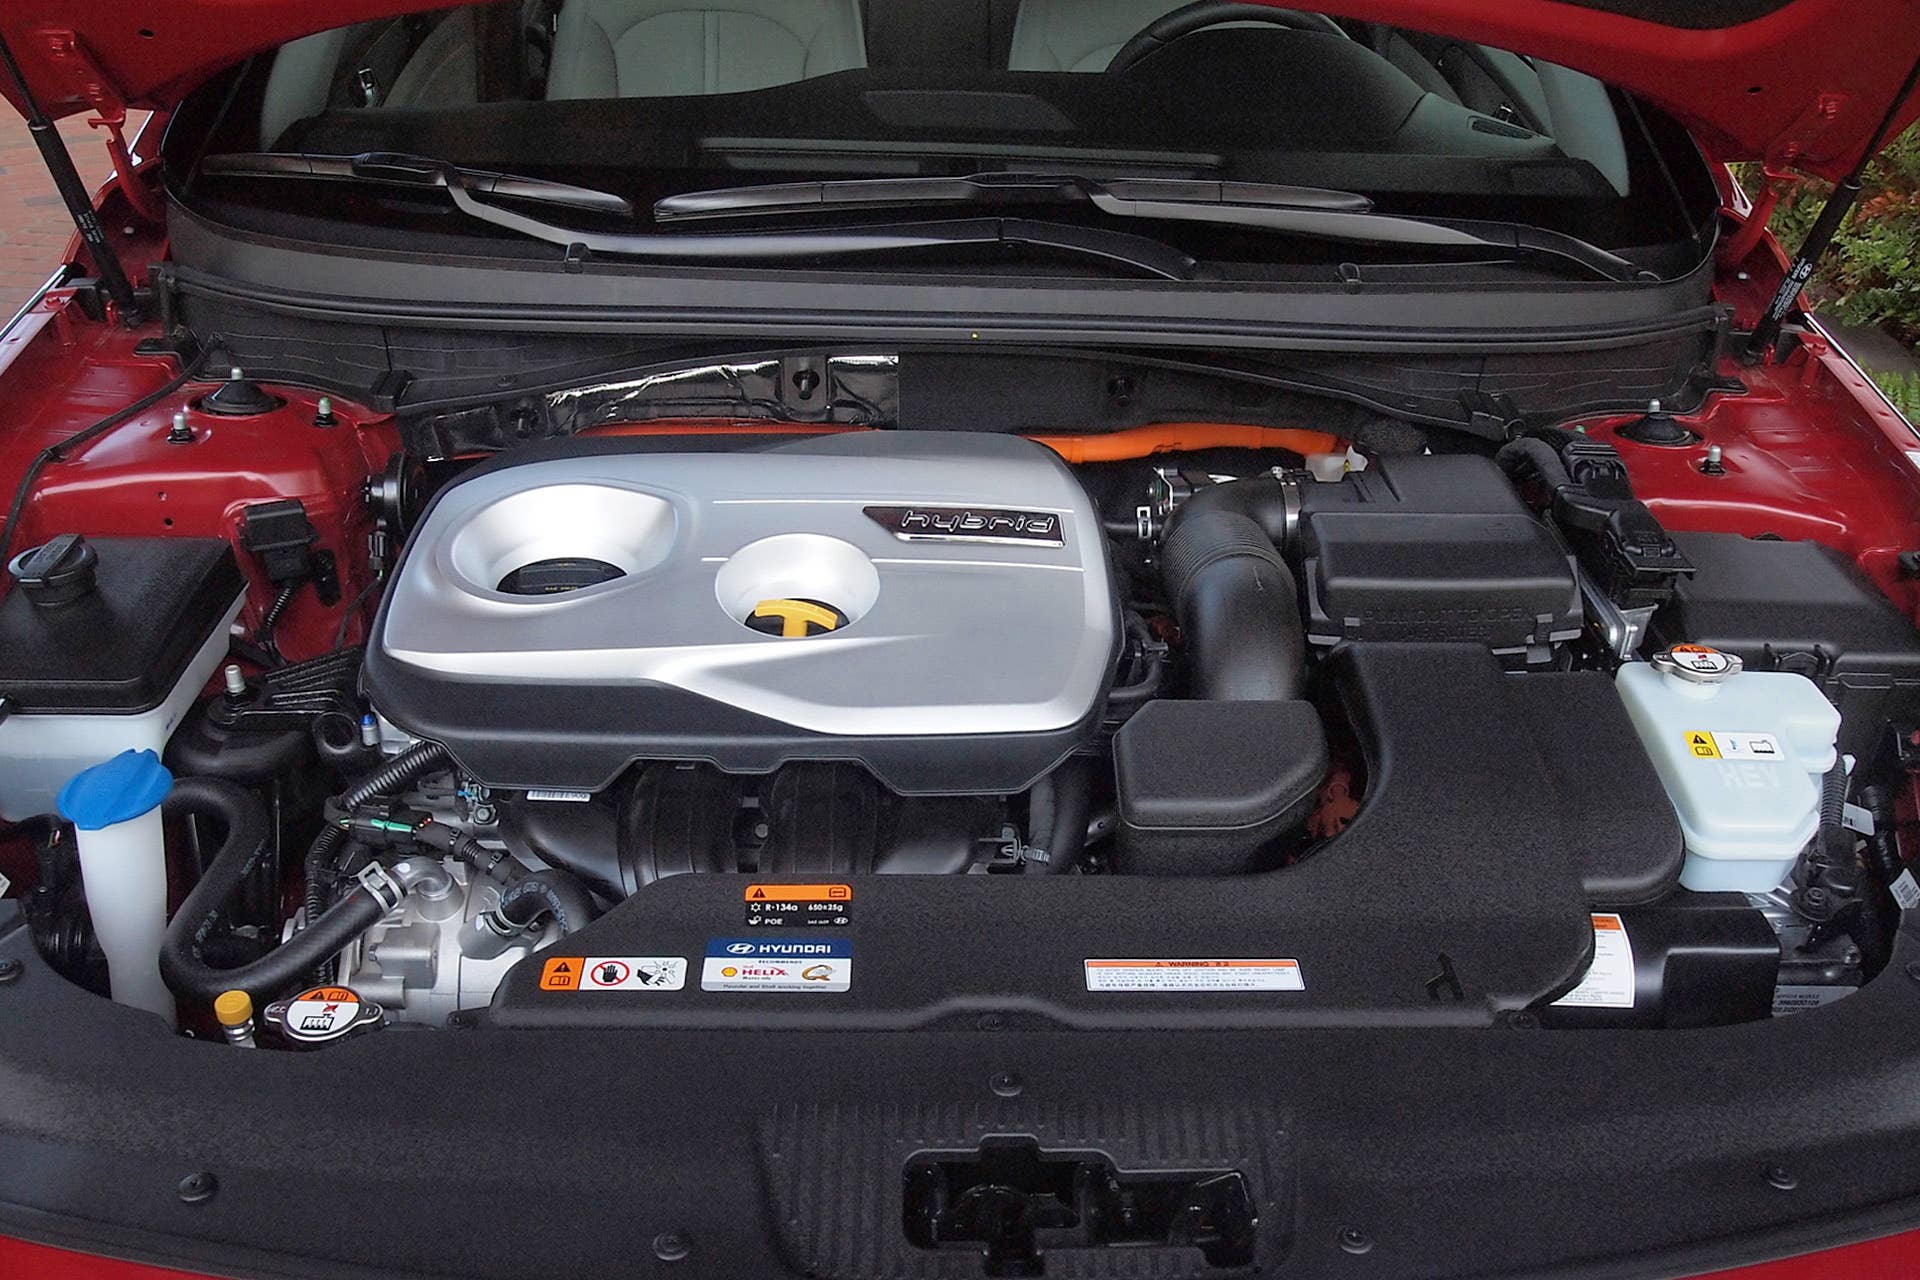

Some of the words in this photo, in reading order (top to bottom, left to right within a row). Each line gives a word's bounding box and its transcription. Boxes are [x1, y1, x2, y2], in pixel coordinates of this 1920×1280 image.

[901, 509, 1055, 533] hybrid
[759, 944, 831, 954] HYUNDAI
[742, 968, 787, 976] HELIX
